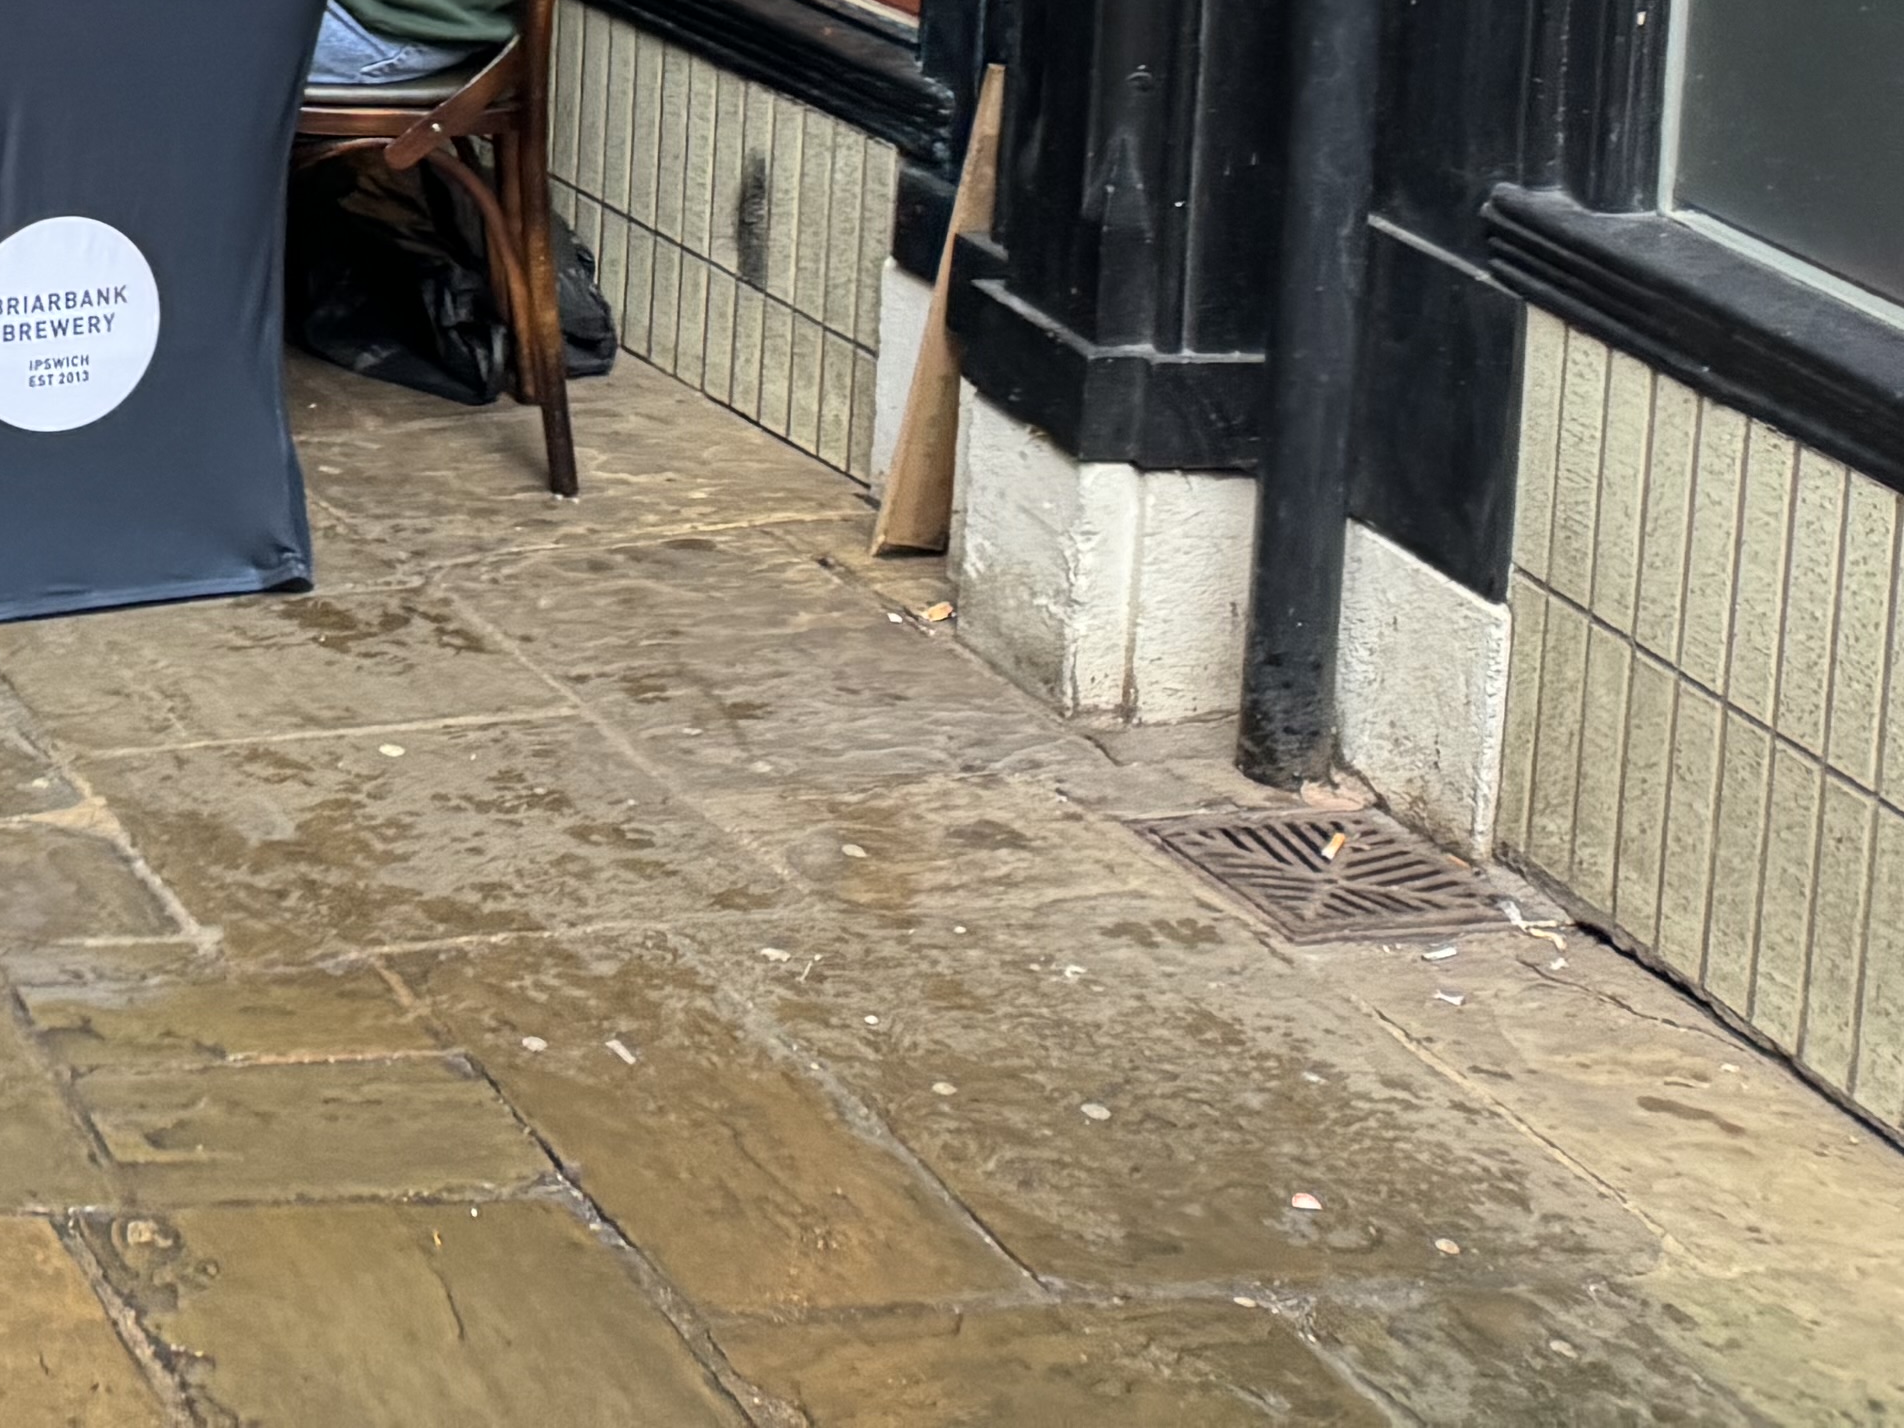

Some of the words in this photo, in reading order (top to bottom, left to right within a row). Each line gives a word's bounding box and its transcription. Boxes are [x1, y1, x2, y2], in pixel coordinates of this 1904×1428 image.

[2, 312, 115, 343] BREWERY
[29, 354, 90, 371] IPSWICH
[28, 373, 54, 387] EST
[58, 369, 90, 385] 2013
